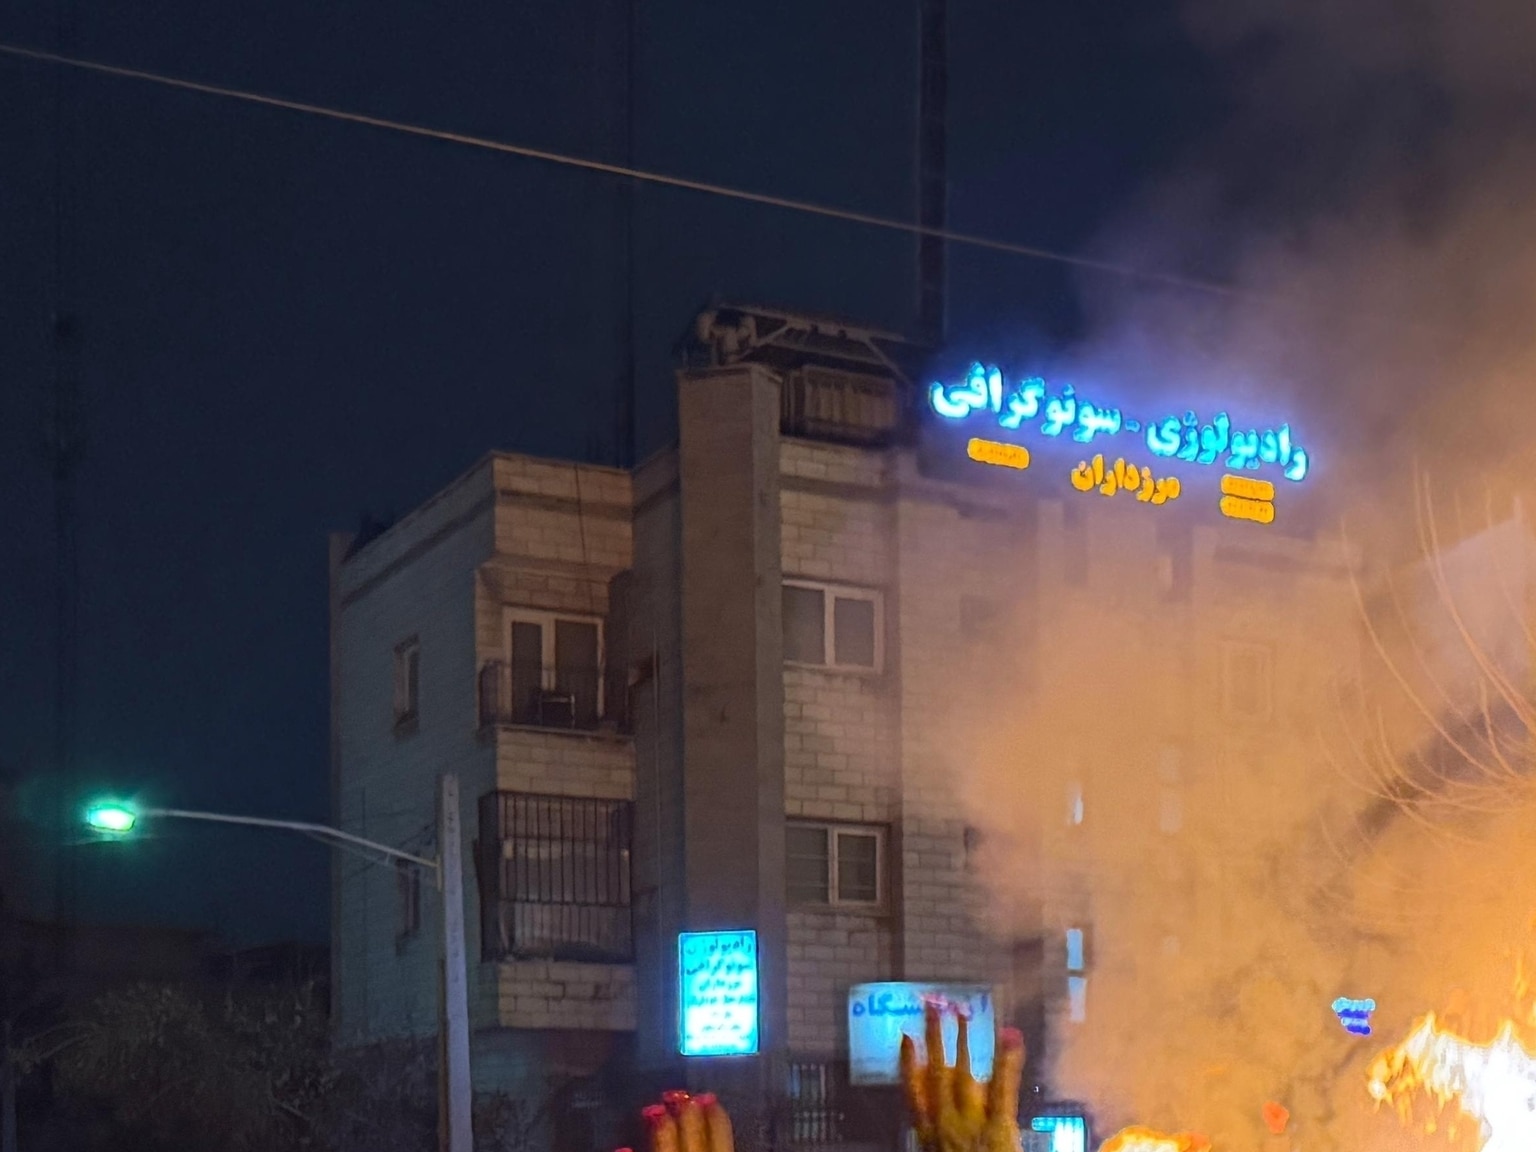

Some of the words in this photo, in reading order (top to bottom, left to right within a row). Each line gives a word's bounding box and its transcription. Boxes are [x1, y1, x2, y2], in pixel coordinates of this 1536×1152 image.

[931, 361, 1122, 443] سونوگرافی
[1070, 453, 1181, 505] مرزداران
[1146, 410, 1307, 481] رادیولوژی
